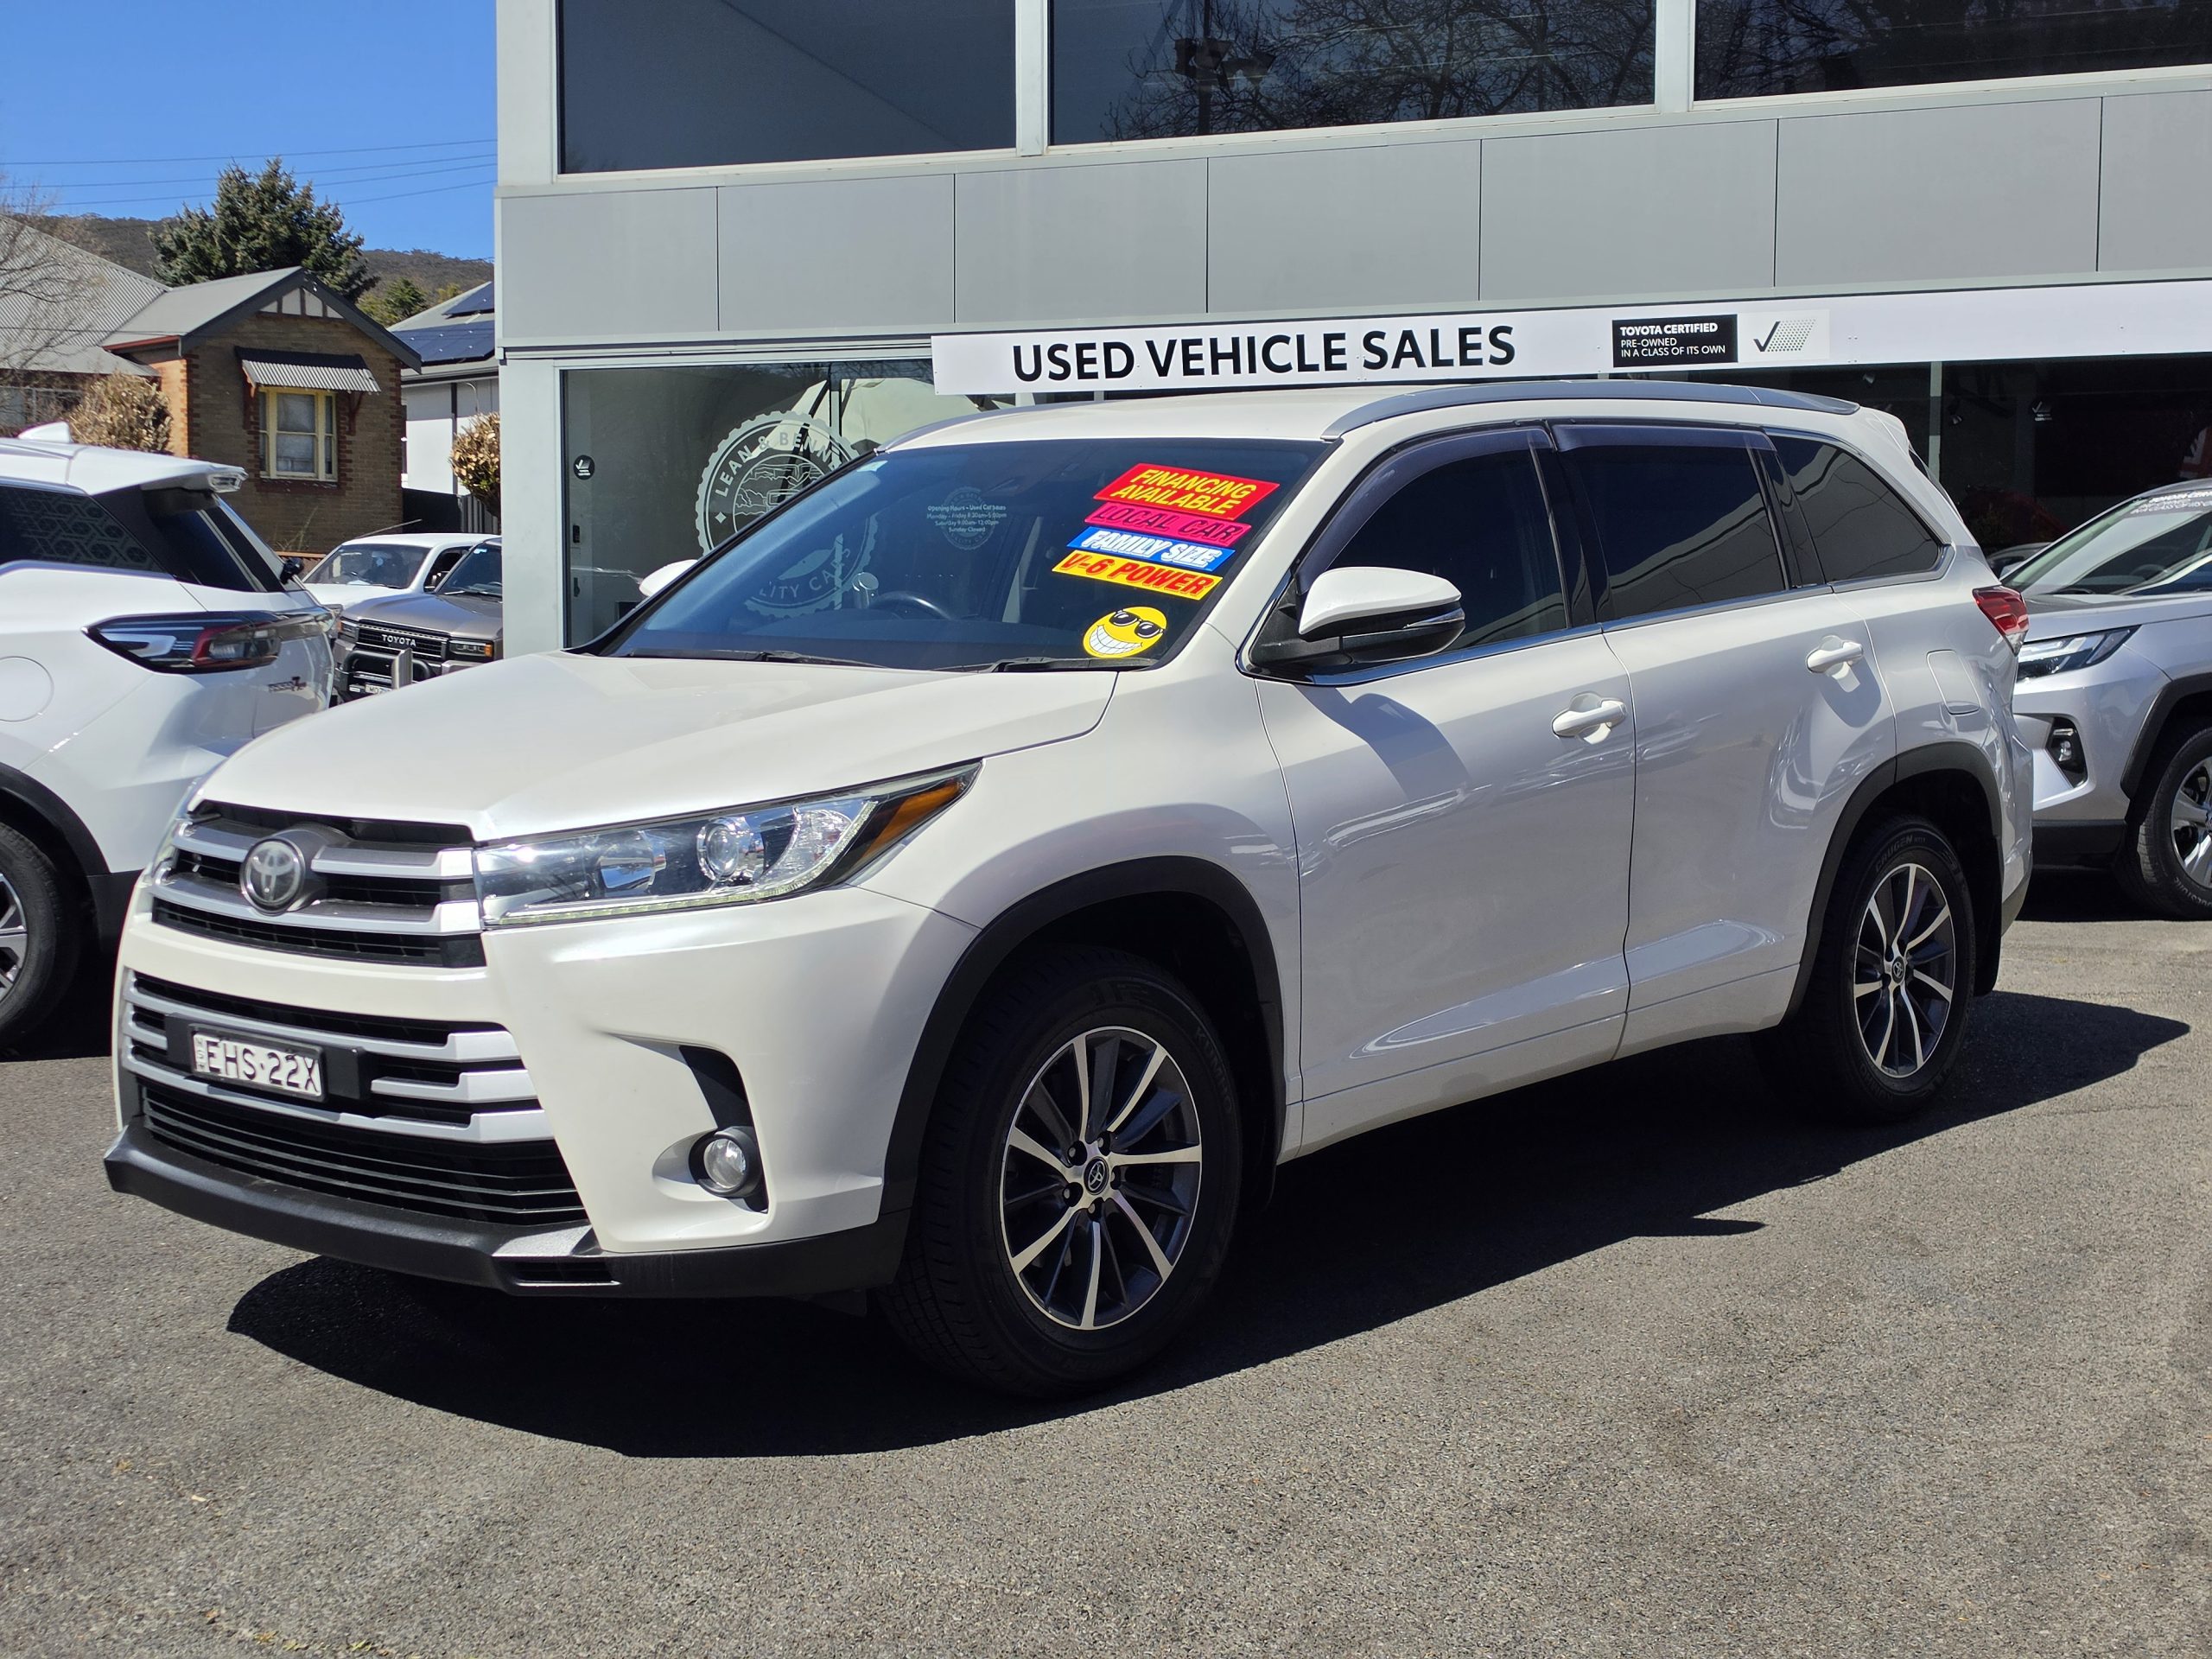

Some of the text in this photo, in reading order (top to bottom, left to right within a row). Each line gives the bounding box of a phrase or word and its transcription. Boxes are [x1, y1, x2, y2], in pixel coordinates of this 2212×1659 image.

[1620, 322, 1718, 336] TOYOTA CERTIFIED
[1621, 338, 1677, 348] PRE-OWNED
[1013, 326, 1515, 382] USED VEHICLE SALES
[1621, 349, 1630, 358] IN
[1641, 347, 1669, 357] CLASS
[1671, 346, 1685, 355] OF
[1687, 346, 1700, 354] ITS
[1701, 345, 1726, 354] OWN
[715, 446, 753, 497] LEAN
[758, 436, 769, 451] &
[1130, 469, 1256, 499] FINANCING
[1110, 486, 1242, 514] AVAILABLE
[1095, 505, 1243, 544] LOCAL CAR
[1081, 531, 1223, 568] FAMILY SIZE
[1058, 553, 1214, 595] V-6 POWER
[381, 634, 416, 646] TOYOTA
